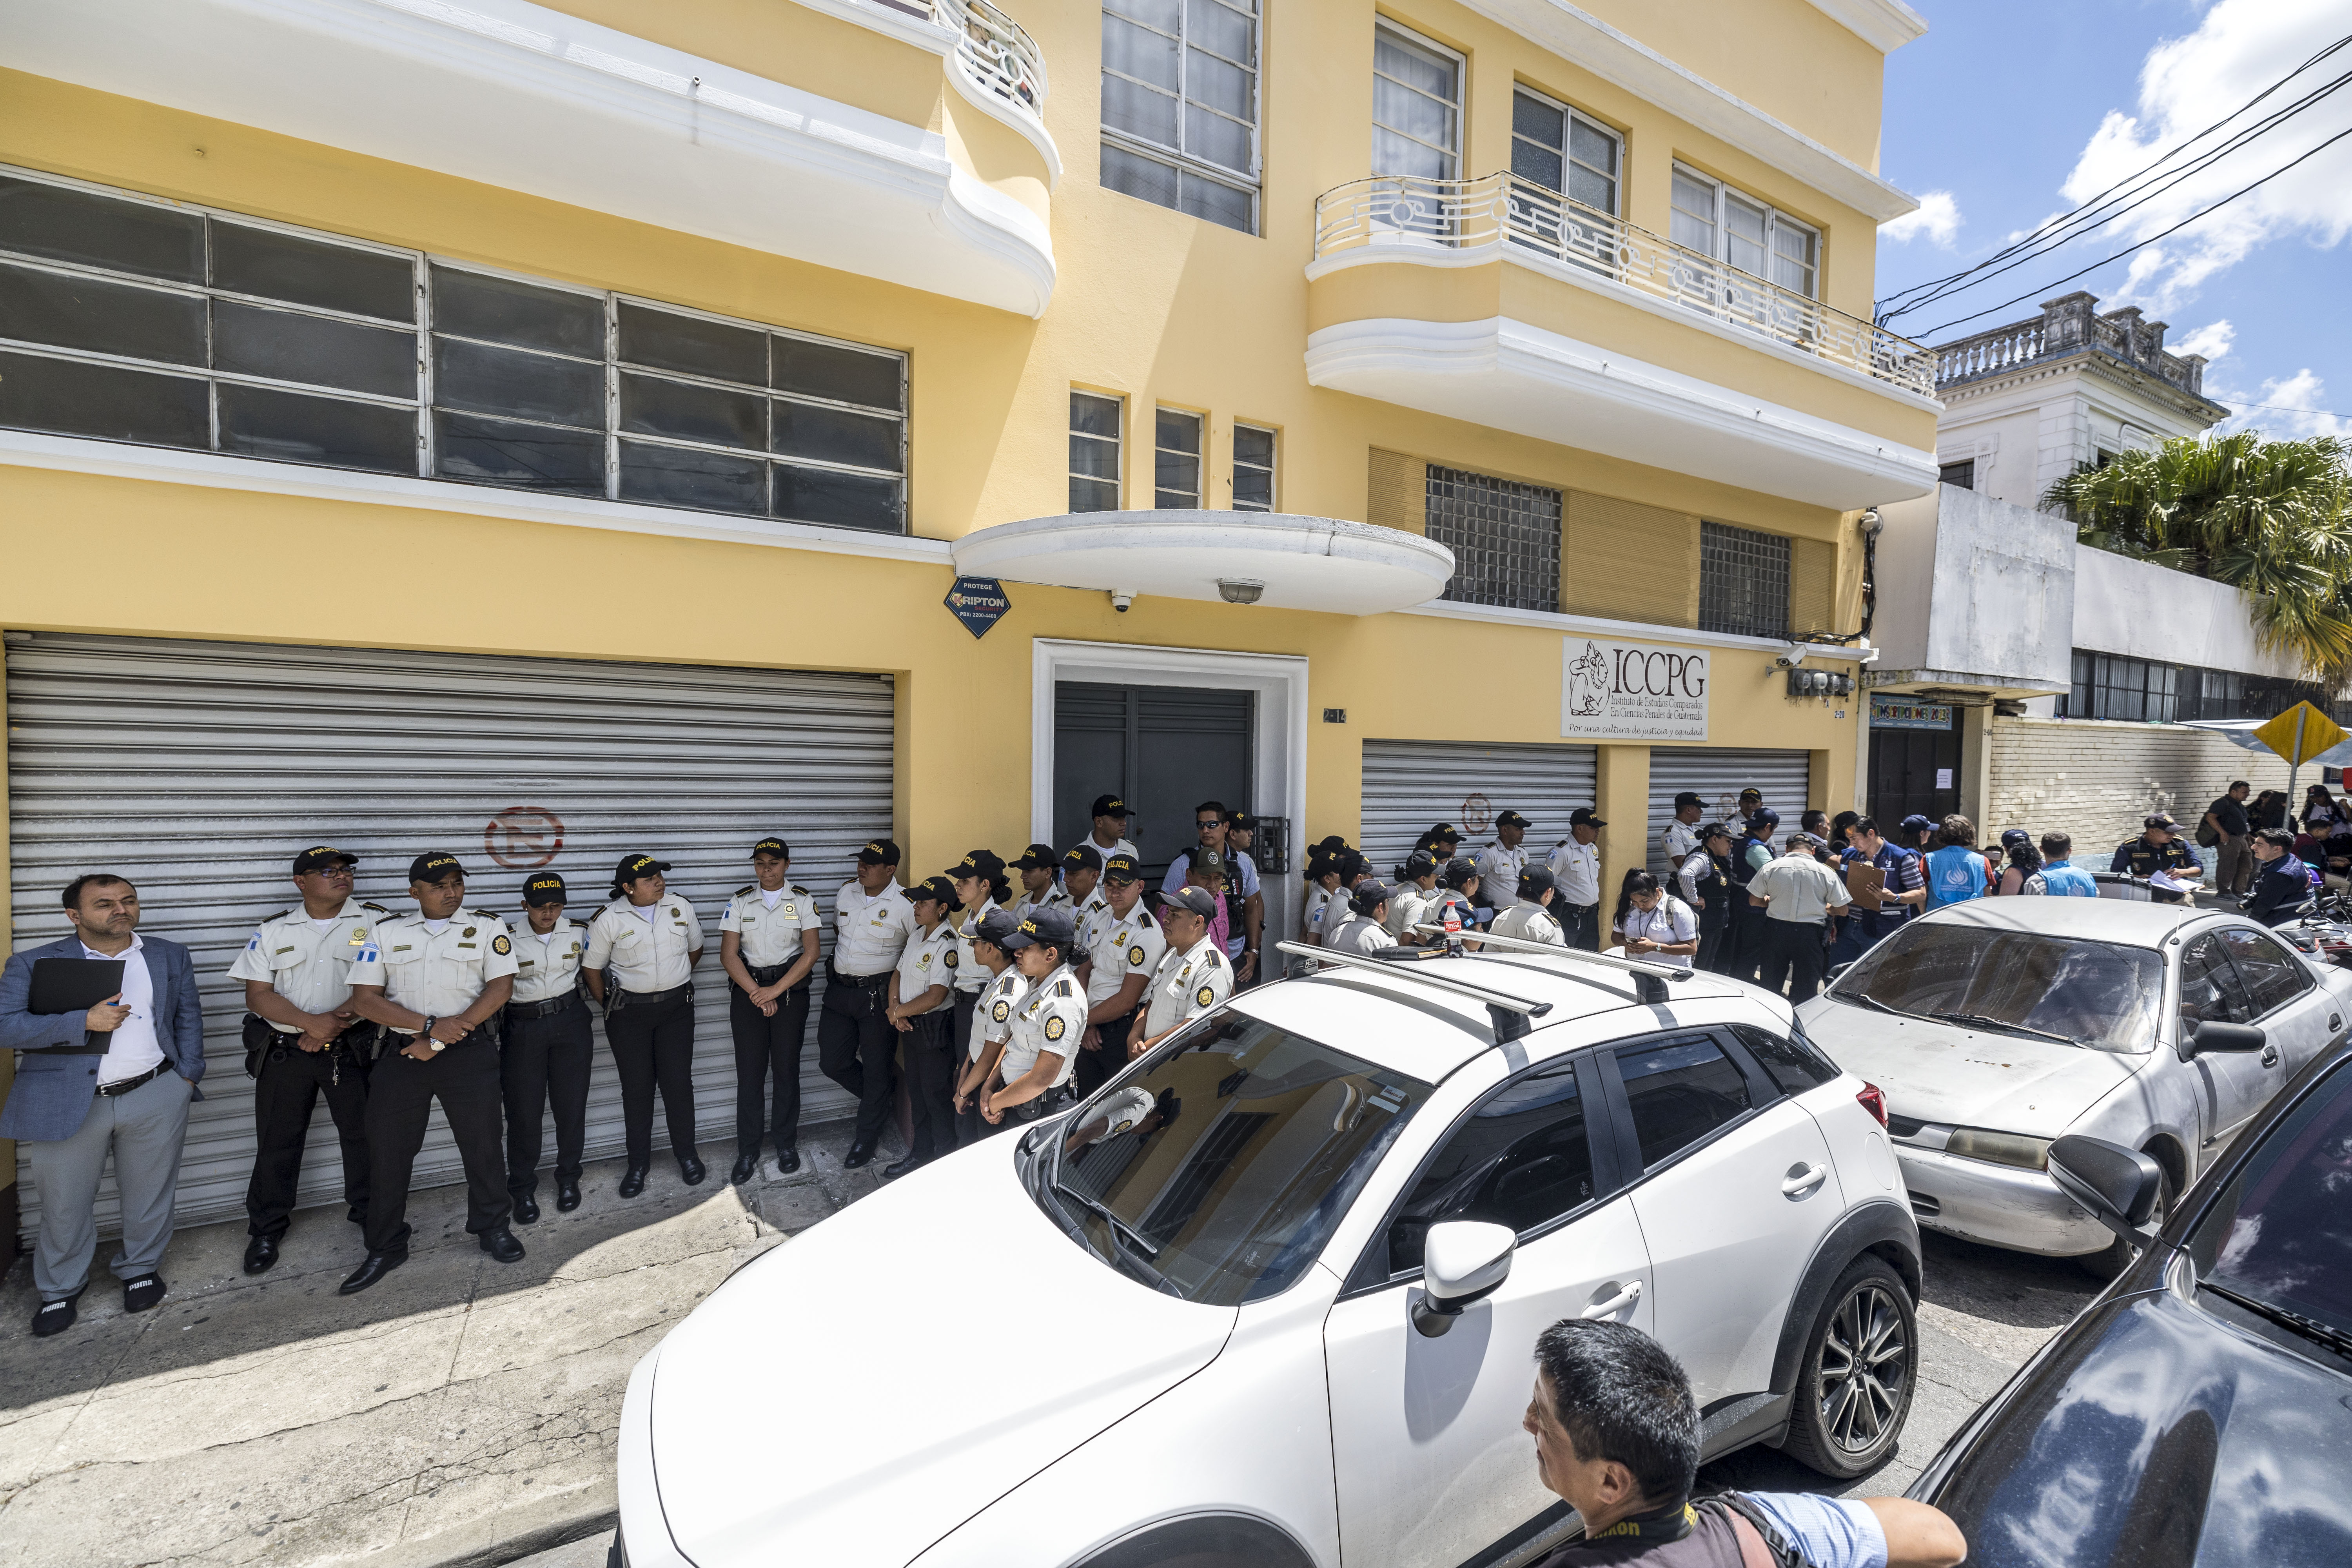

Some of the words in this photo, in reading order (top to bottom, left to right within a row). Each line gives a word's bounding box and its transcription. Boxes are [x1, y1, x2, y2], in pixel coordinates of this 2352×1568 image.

[954, 595, 1004, 607] KRIPTON
[1612, 649, 1705, 698] ICCPG
[1611, 695, 1635, 706] Instituto
[1637, 698, 1644, 706] de
[1645, 697, 1668, 708] Estudios
[1669, 699, 1703, 711] Comparados
[1323, 709, 1347, 723] 2-14
[1611, 707, 1619, 717] En
[1620, 707, 1644, 718] Ciencias
[1645, 709, 1666, 719] Penales
[1666, 710, 1673, 719] de
[1674, 711, 1702, 720] Guatemala
[1835, 710, 1845, 719] 2-20
[1876, 704, 1929, 722] INSCRIPCIONES
[1931, 707, 1947, 722] 2023
[1569, 723, 1583, 732] Por
[1602, 724, 1631, 734] cultura
[1632, 725, 1641, 734] de
[1641, 726, 1667, 737] justicia
[1675, 727, 1704, 738] equidad
[756, 842, 780, 850] POLICIA
[426, 858, 458, 869] POLICIA
[632, 857, 656, 871] POLIC
[1106, 860, 1129, 870] POLICIA
[533, 880, 561, 890] POLICIA
